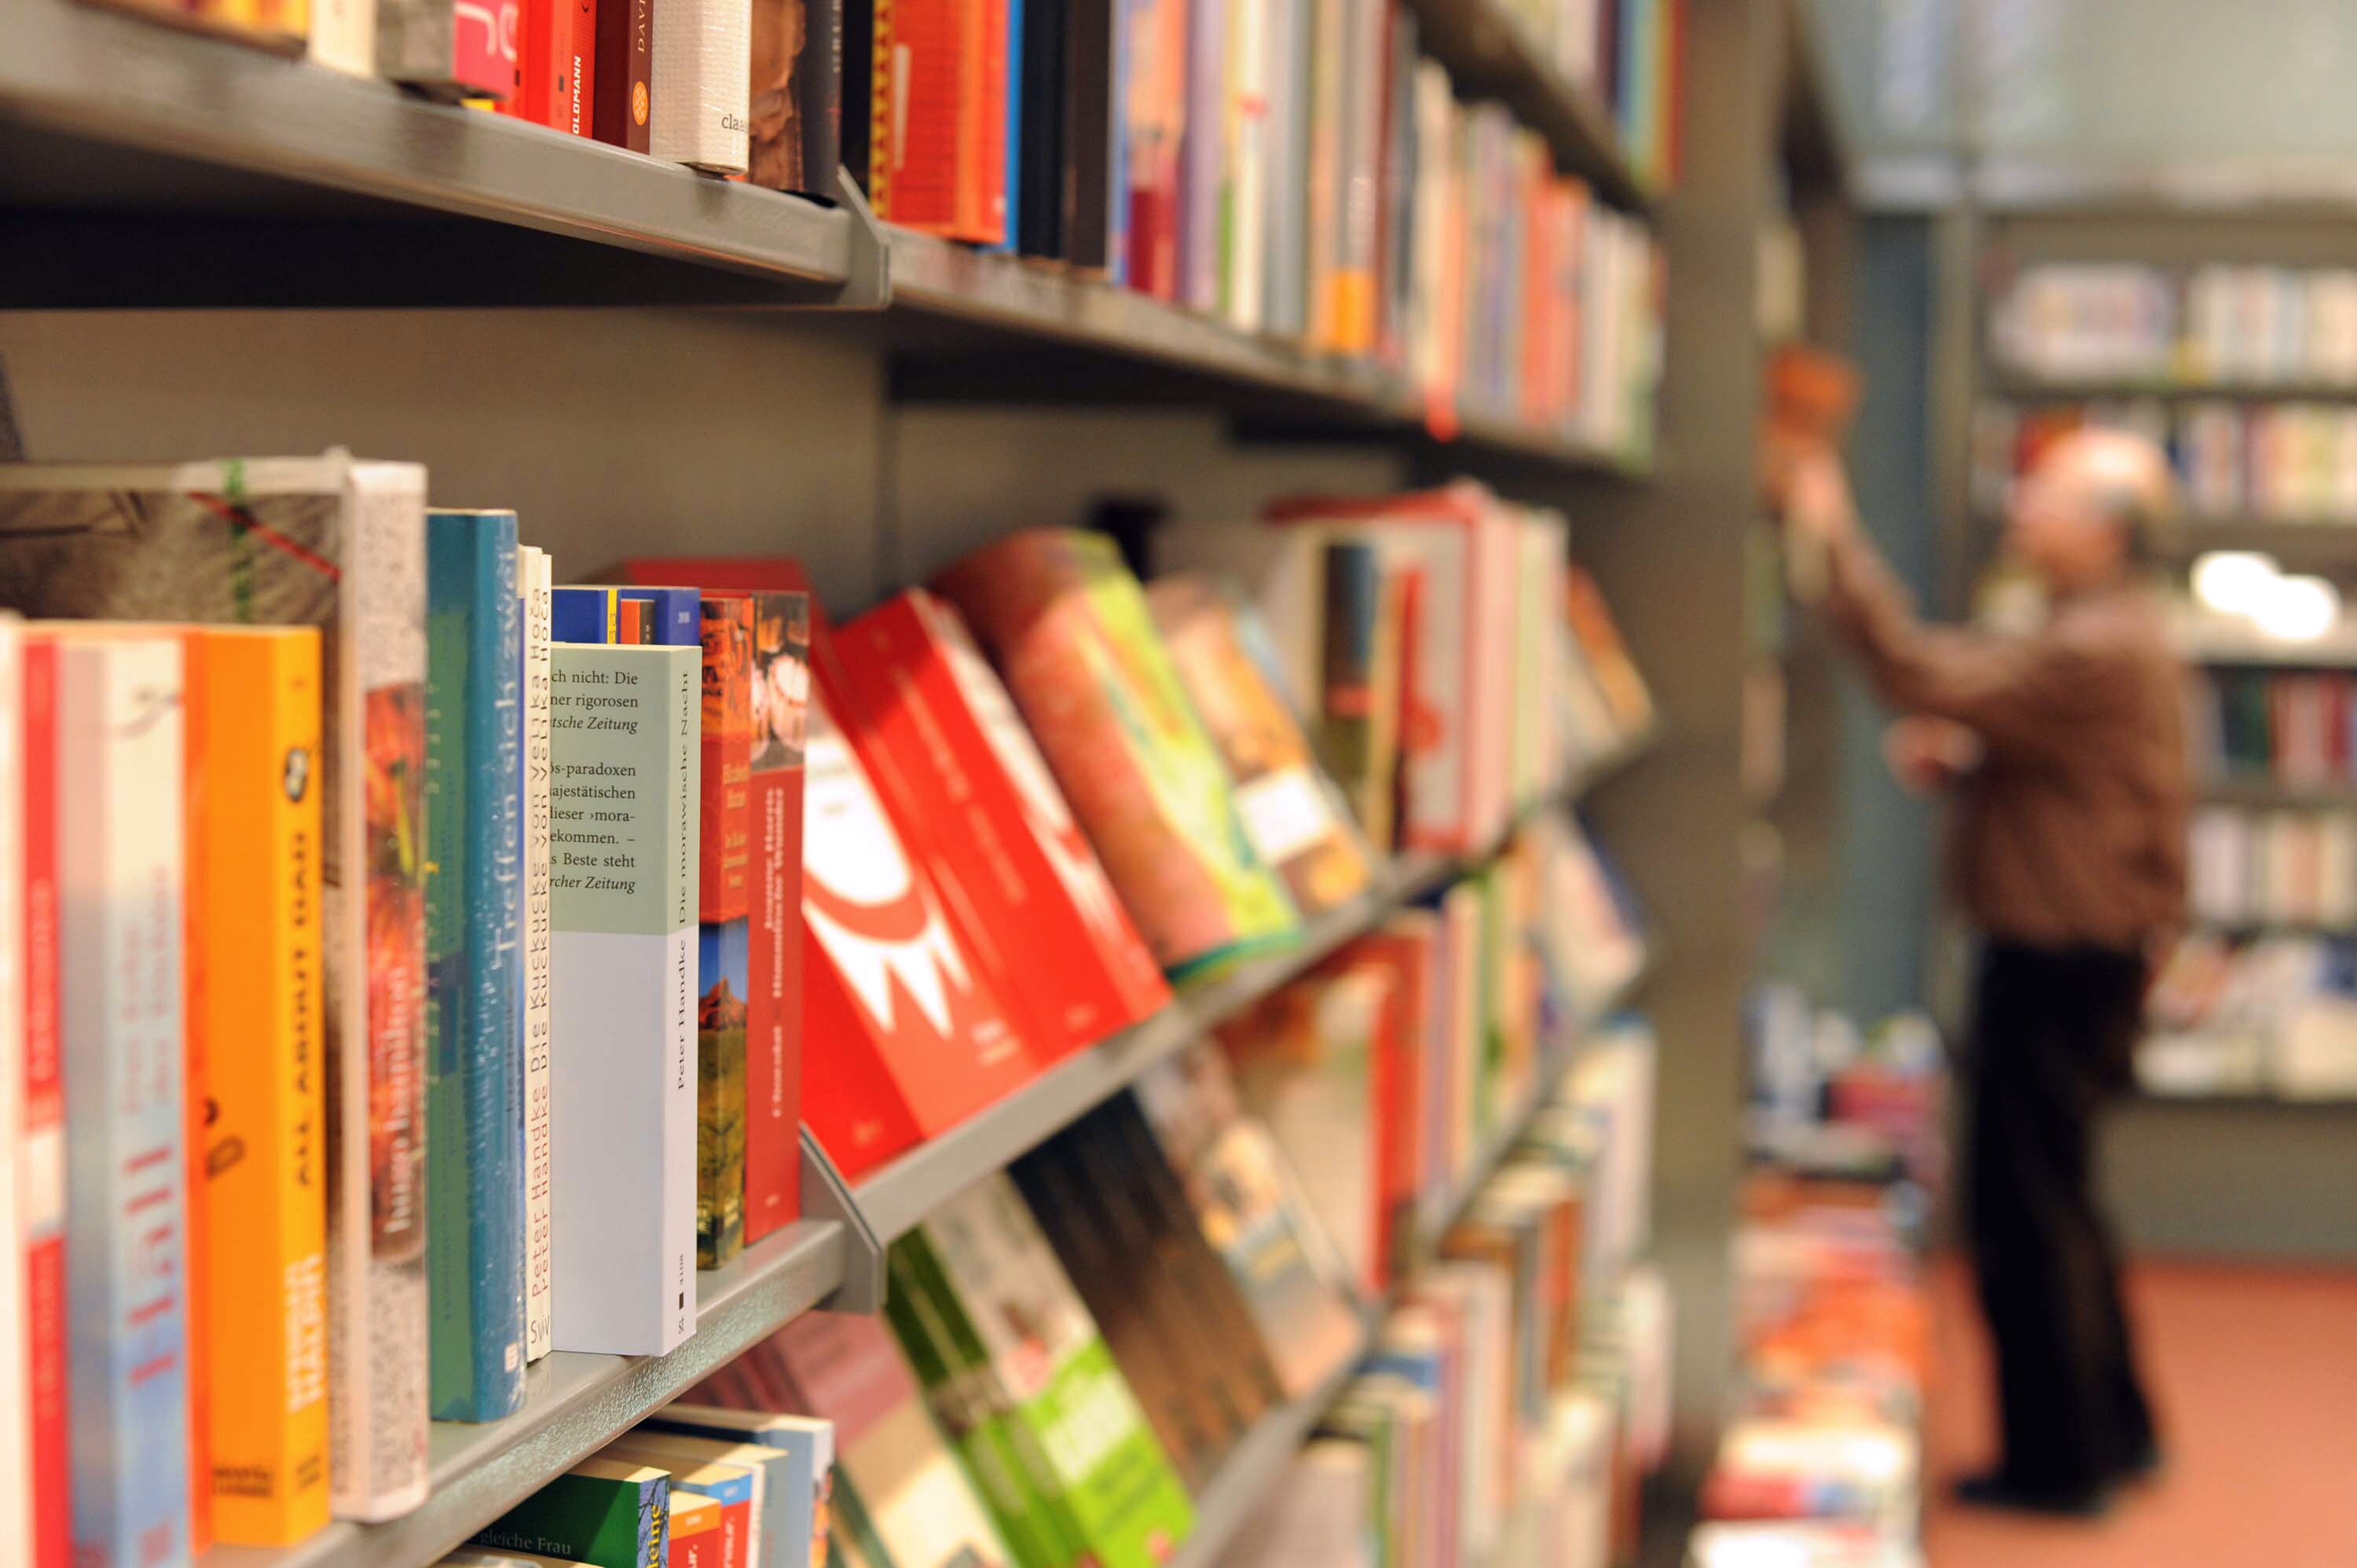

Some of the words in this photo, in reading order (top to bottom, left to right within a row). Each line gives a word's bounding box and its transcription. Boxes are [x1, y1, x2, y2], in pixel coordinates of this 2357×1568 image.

[572, 670, 609, 684] nicht:
[614, 672, 638, 684] Die
[575, 694, 639, 710] rigorosen
[586, 716, 638, 735] Zeitung
[679, 745, 687, 880] morawische
[563, 852, 598, 866] Beste
[603, 854, 636, 868] steht
[585, 876, 636, 894] Zeitung
[677, 940, 686, 1027] Handke
[530, 1024, 541, 1073] Die
[530, 1088, 541, 1200] Handke
[531, 1212, 541, 1297] Peter
[537, 1537, 572, 1555] Frau
